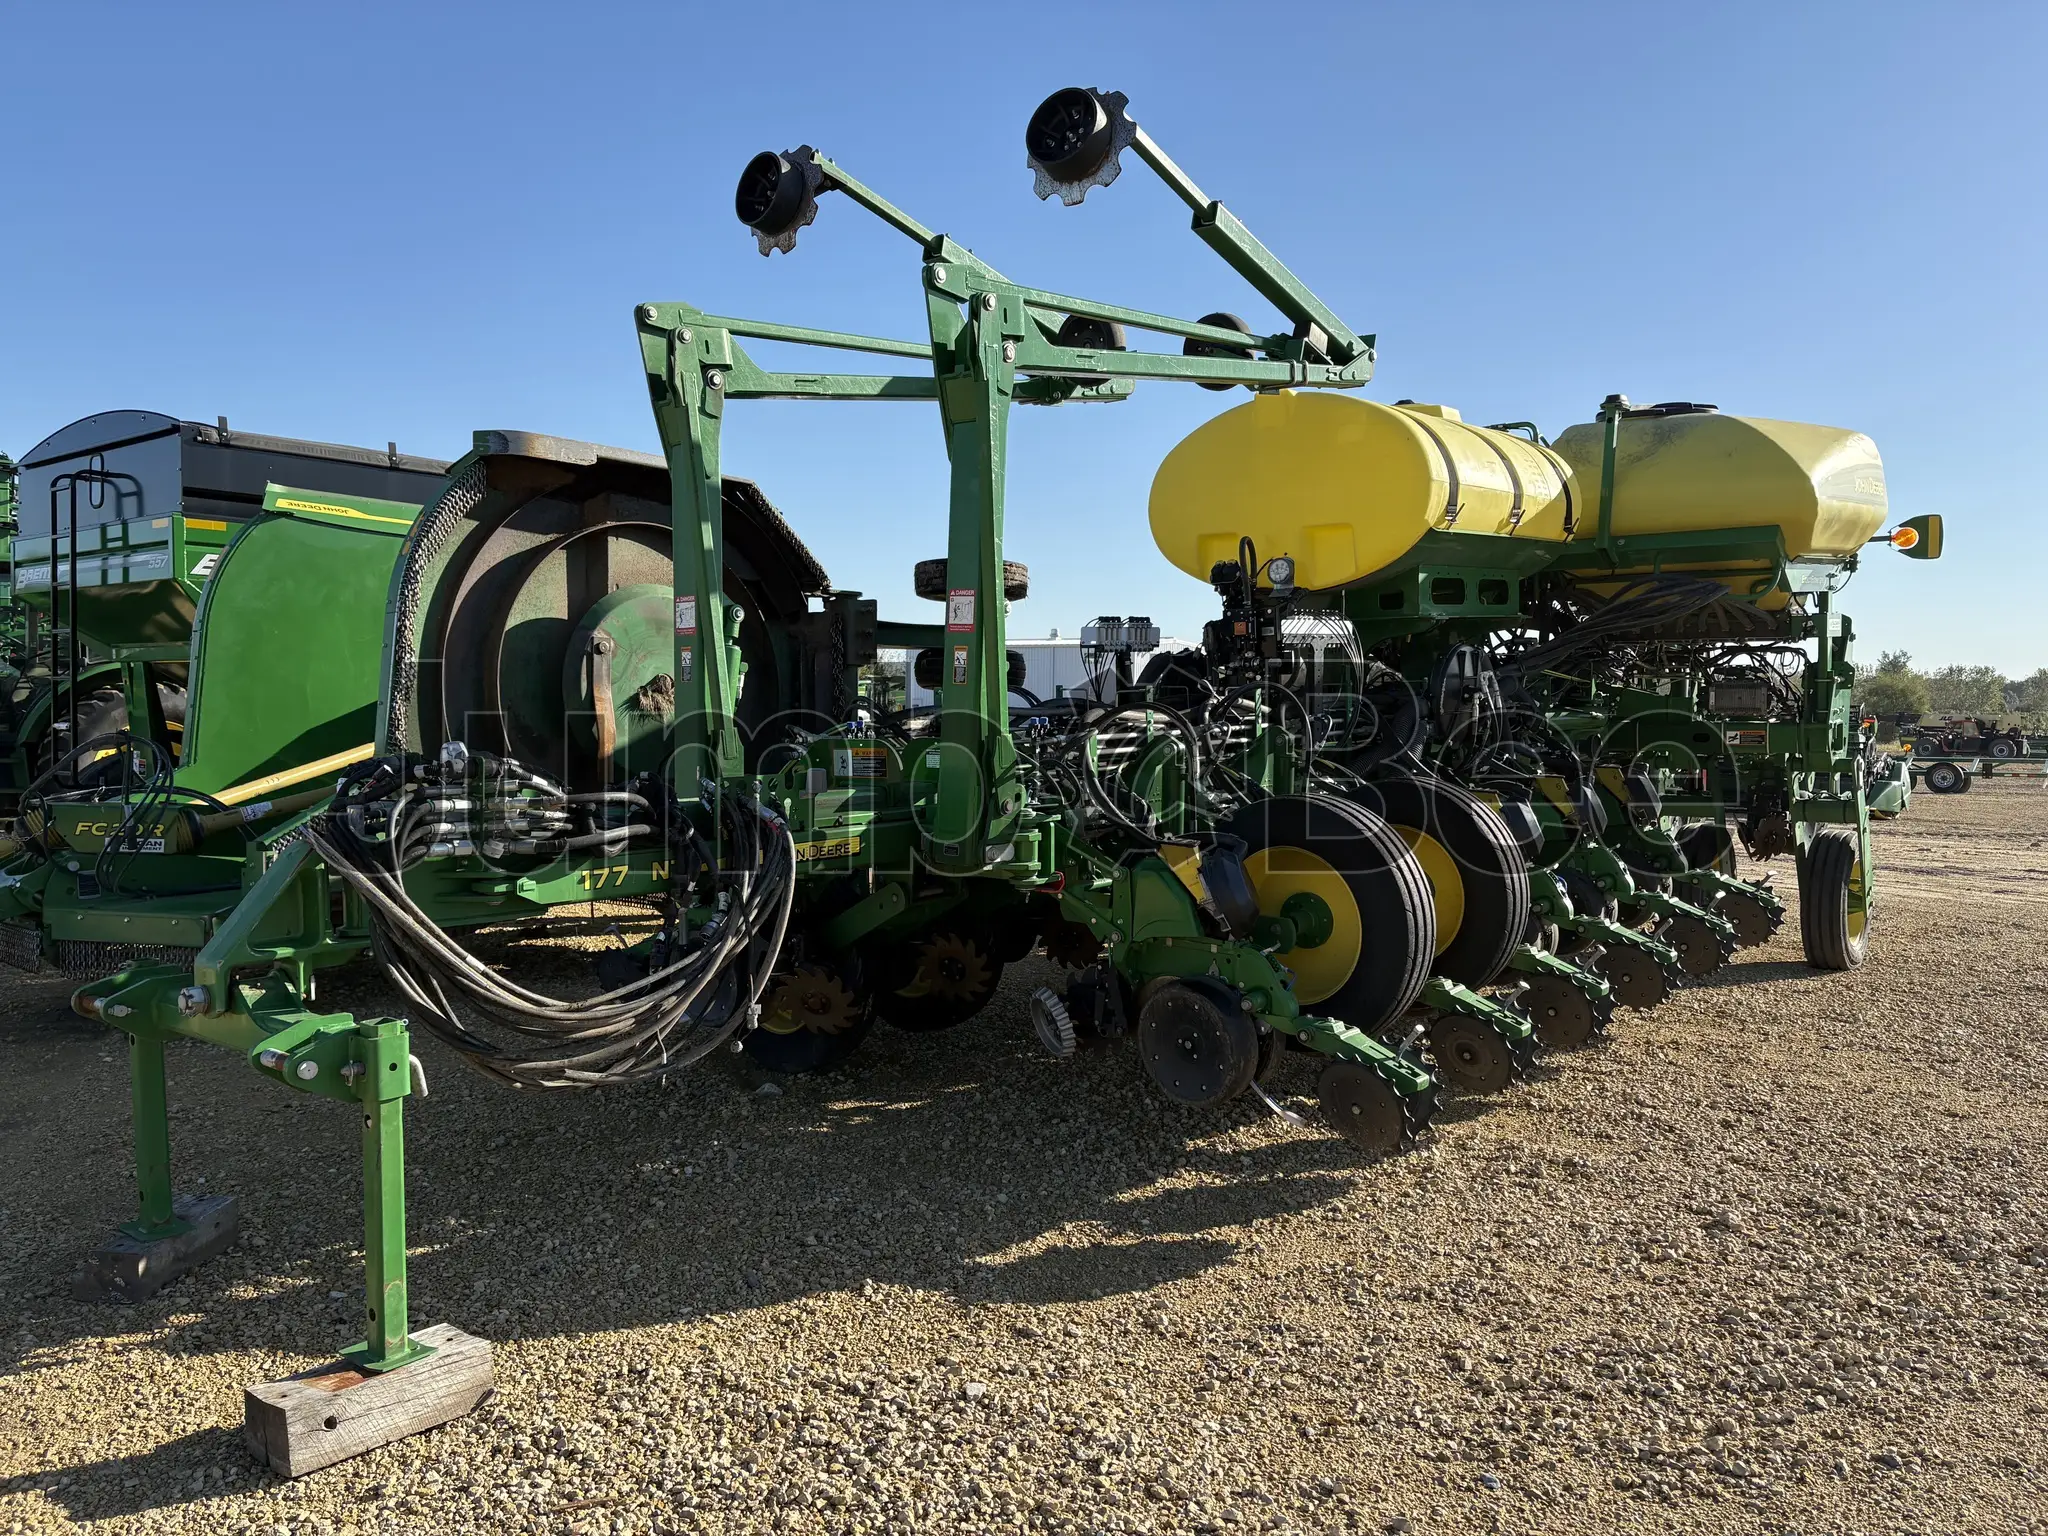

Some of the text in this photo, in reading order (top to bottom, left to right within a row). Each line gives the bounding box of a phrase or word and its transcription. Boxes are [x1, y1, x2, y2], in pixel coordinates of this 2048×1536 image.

[286, 501, 350, 515] JOHN DEERE
[148, 555, 169, 570] 557
[16, 563, 60, 590] BREN
[808, 843, 851, 859] DEERE
[581, 865, 628, 890] 177
